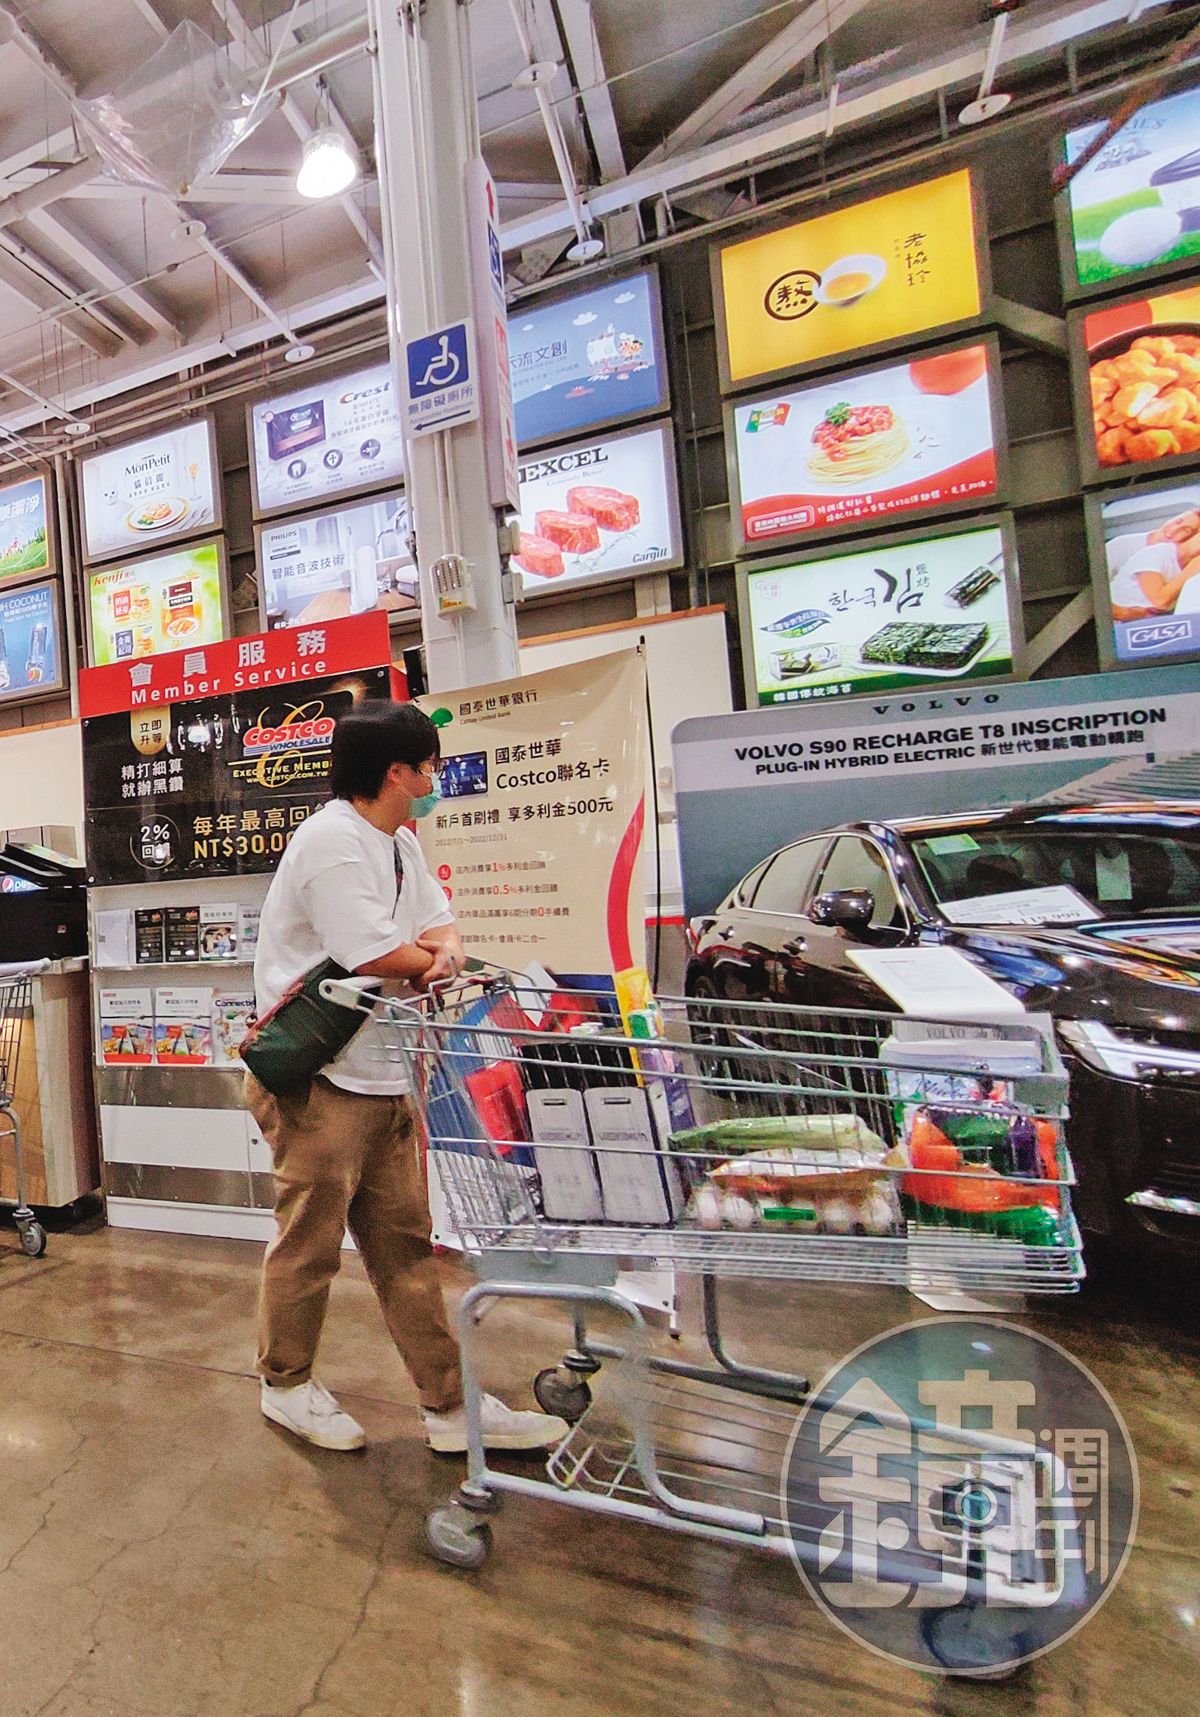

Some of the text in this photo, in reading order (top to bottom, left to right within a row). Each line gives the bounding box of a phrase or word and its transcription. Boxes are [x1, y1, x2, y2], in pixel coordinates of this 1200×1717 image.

[903, 233, 931, 288] 老協珍
[340, 382, 390, 404] Crest
[408, 385, 474, 416] 無障礙廁所
[518, 447, 609, 484] EXCEL
[271, 530, 297, 541] PHILIPS
[272, 554, 344, 579] 智能音波技術
[633, 547, 668, 563] Cargill
[94, 570, 123, 586] Kenji
[9, 591, 48, 609] COCONUT
[129, 630, 326, 687] 會員服務
[131, 660, 326, 705] Member Service
[460, 689, 538, 715] 國泰世華銀行
[873, 693, 1000, 715] VOLVO
[140, 719, 162, 733] 立即
[243, 717, 335, 747] COSTCO
[735, 707, 1167, 761] VOLVO S90 RECHARGE T8 INSCRIPTION
[140, 733, 162, 745] 升等
[268, 735, 331, 751] WHOLESALE
[495, 738, 561, 765] 國泰世華
[755, 730, 1145, 775] PLUG-IN HYBRID ELECTRIC 新世代雙能電動轎跑
[121, 758, 184, 780] 精打細算
[294, 760, 333, 772] MEMB
[496, 757, 610, 789] Costco聯名卡
[121, 776, 184, 798] 就辦黑鑽
[193, 803, 325, 836] 每年最高回
[435, 797, 613, 829] 新戶首刷禮 享多利金500元
[140, 824, 170, 843] 2%
[926, 1027, 966, 1038] VOLVO
